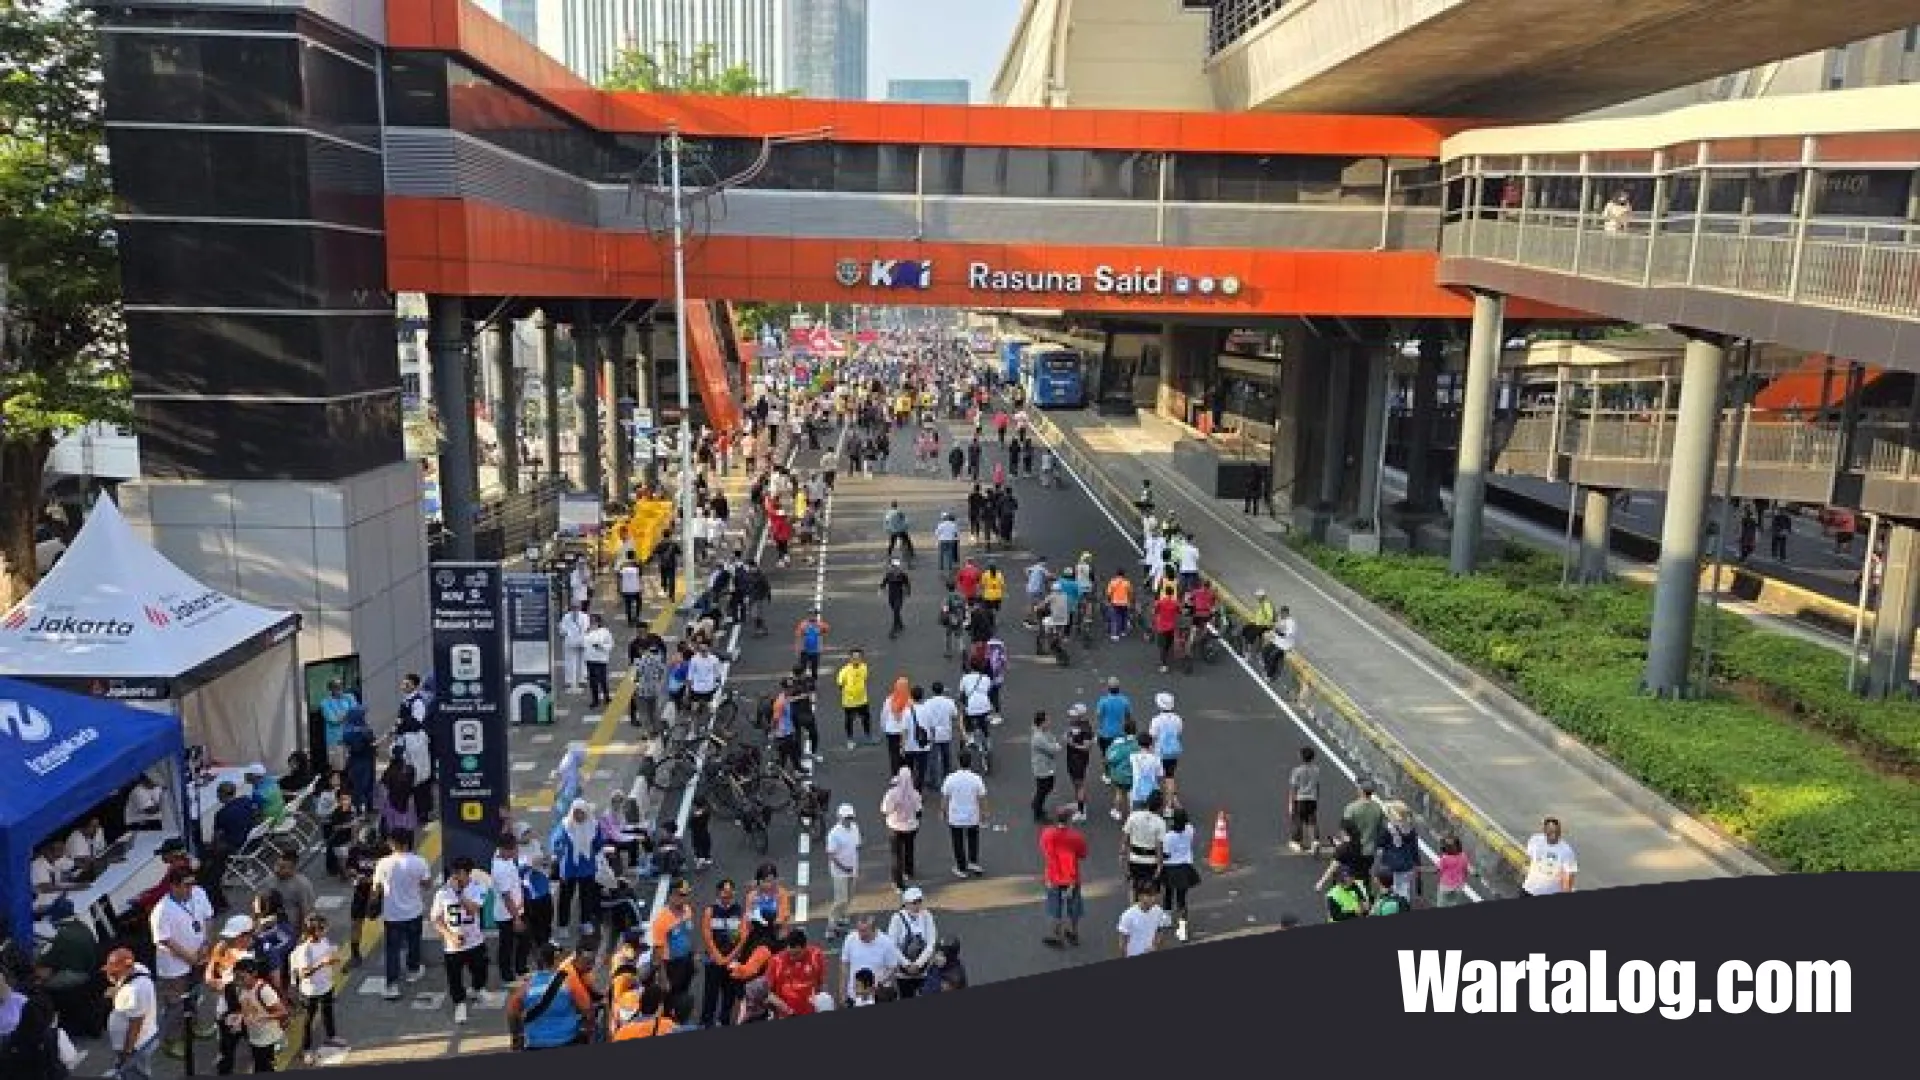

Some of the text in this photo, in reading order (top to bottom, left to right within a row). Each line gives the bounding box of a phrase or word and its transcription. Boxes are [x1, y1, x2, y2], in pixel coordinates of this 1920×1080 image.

[871, 260, 1161, 294] Ki Rasuna Said
[29, 614, 135, 636] Jakarta
